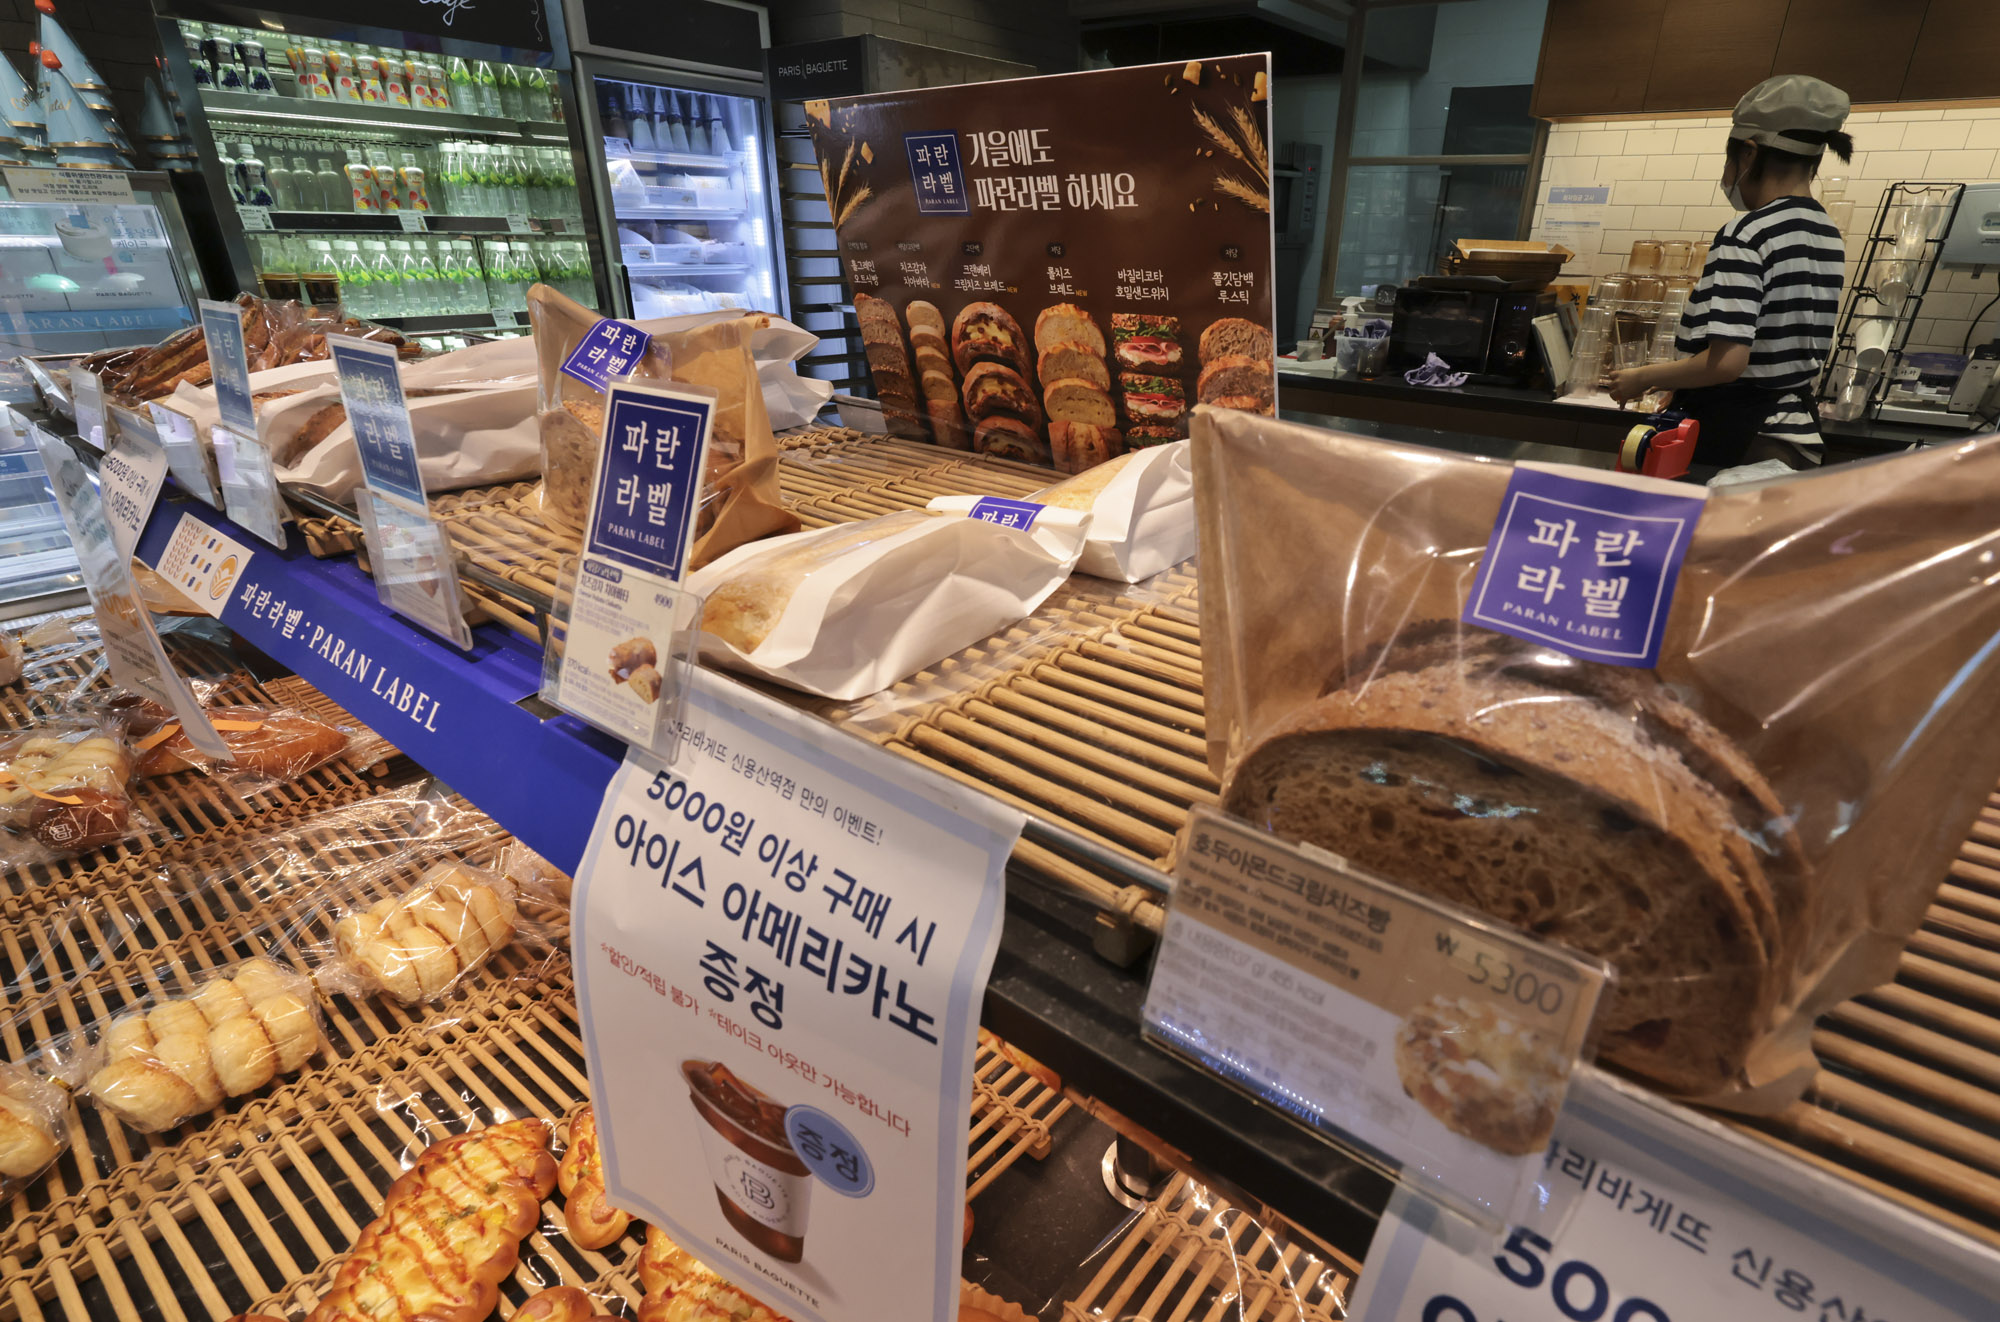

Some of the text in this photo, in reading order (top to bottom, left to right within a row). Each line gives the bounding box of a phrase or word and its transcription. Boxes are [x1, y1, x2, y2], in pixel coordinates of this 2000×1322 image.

[778, 60, 849, 77] PARIS BAGUETTE
[915, 143, 950, 168] 파란
[966, 128, 1055, 168] 가을에도
[922, 171, 956, 194] 라벨
[973, 172, 1139, 212] 파란라벨 하세요
[1115, 285, 1170, 302] 호밀샌드위치
[1117, 267, 1164, 284] 바질리코타
[1211, 270, 1254, 288] 쫄깃담백
[1217, 289, 1250, 305] 루스틱
[587, 345, 628, 375] 라벨
[601, 324, 638, 356] 파란
[364, 419, 404, 460] 라벨
[622, 420, 681, 471] 파란
[615, 474, 673, 527] 라벨
[608, 522, 666, 550] PARAN LABEL
[1527, 518, 1645, 568] 파란
[1516, 563, 1630, 620] 라벨
[1502, 600, 1624, 641] PARAN LABEL
[308, 624, 373, 684] PARAN
[371, 665, 441, 733] LABEL
[731, 753, 797, 799] 신용산역점
[800, 786, 828, 817] 만의
[833, 804, 884, 847] 이벤트!
[646, 769, 937, 967] 5000원 이상 구매 시
[614, 813, 939, 1045] 아이스 아메리카노
[698, 939, 786, 1031] 증정
[1466, 951, 1564, 1016] 5300
[670, 984, 702, 1018] 불가
[767, 1040, 818, 1085] 아웃만
[822, 1072, 912, 1138] 가능합니다
[796, 1120, 860, 1185] 증정
[715, 1236, 821, 1310] PARIS BAGUETTE
